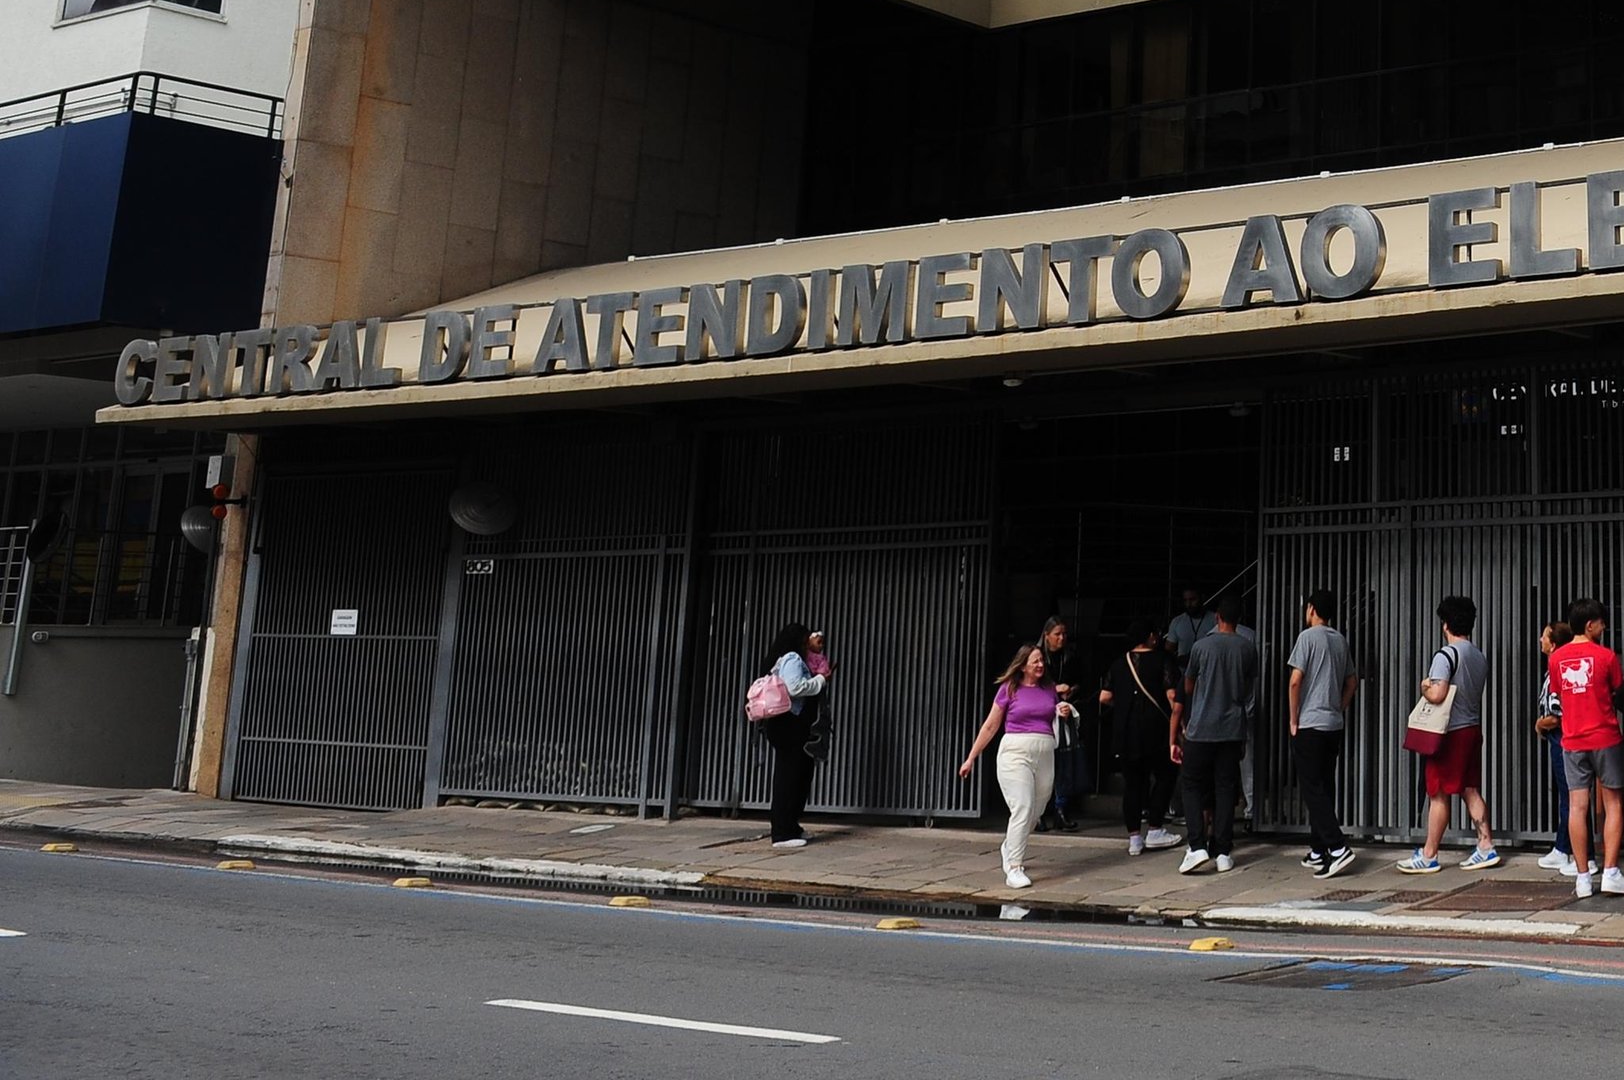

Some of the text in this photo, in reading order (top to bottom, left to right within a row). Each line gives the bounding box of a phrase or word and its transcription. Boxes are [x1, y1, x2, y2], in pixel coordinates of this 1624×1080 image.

[115, 317, 401, 405] CENTRAL
[419, 304, 520, 384] DE
[532, 227, 1191, 374] ATENDIMENTO
[1221, 203, 1386, 307] AO
[467, 561, 491, 572] 805
